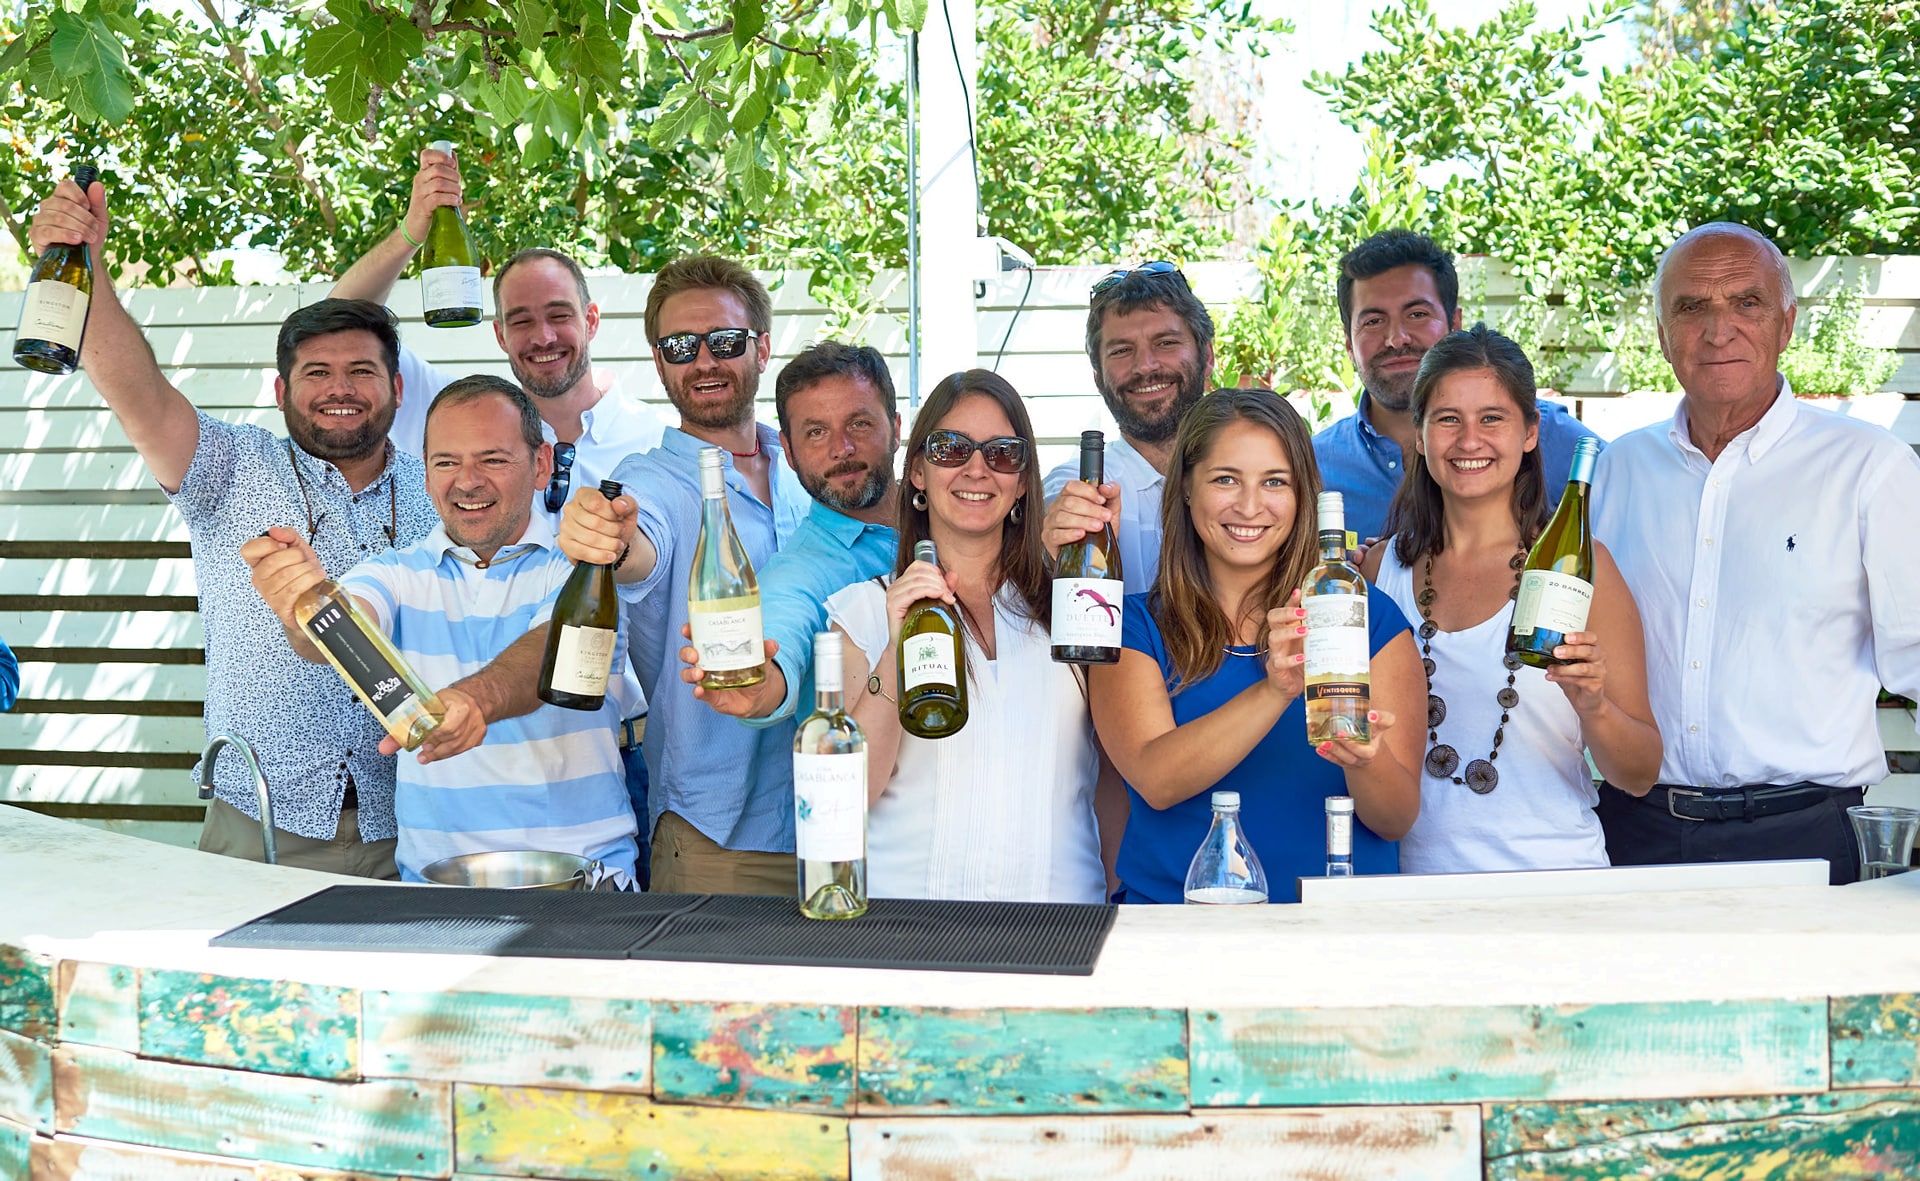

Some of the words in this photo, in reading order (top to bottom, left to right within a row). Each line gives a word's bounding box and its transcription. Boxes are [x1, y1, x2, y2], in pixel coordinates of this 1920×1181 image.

[314, 608, 341, 634] AVID
[911, 663, 949, 673] RITUAL
[1317, 685, 1361, 699] VENTISQUERO
